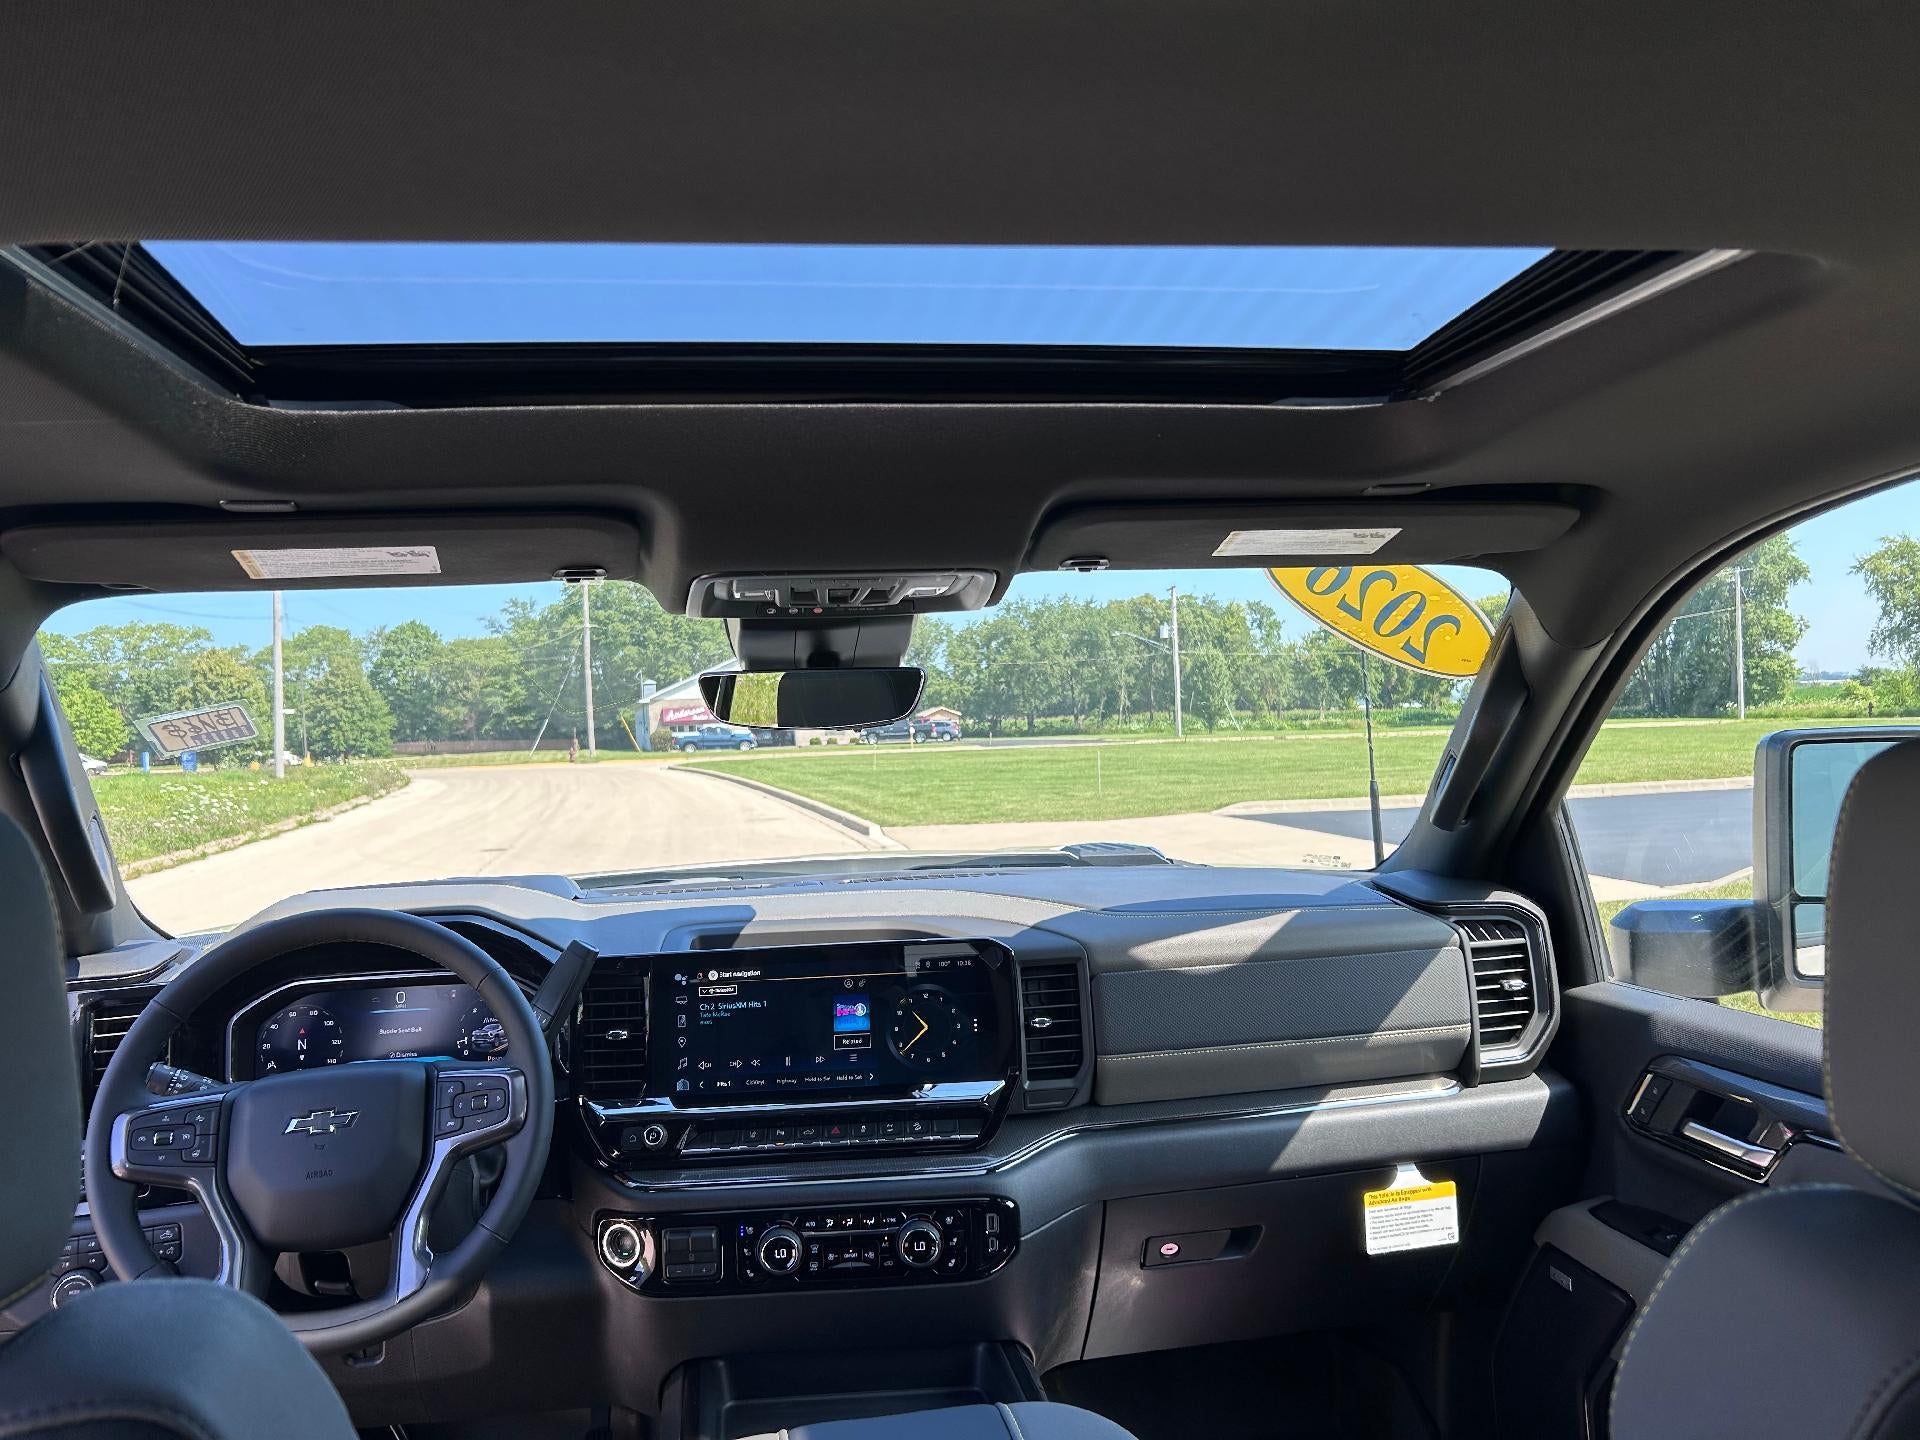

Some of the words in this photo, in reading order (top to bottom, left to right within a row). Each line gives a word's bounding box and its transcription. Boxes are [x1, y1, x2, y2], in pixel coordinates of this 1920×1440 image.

[395, 991, 406, 1004] 0
[718, 1001, 747, 1010] SiriusXM
[297, 1038, 307, 1051] N
